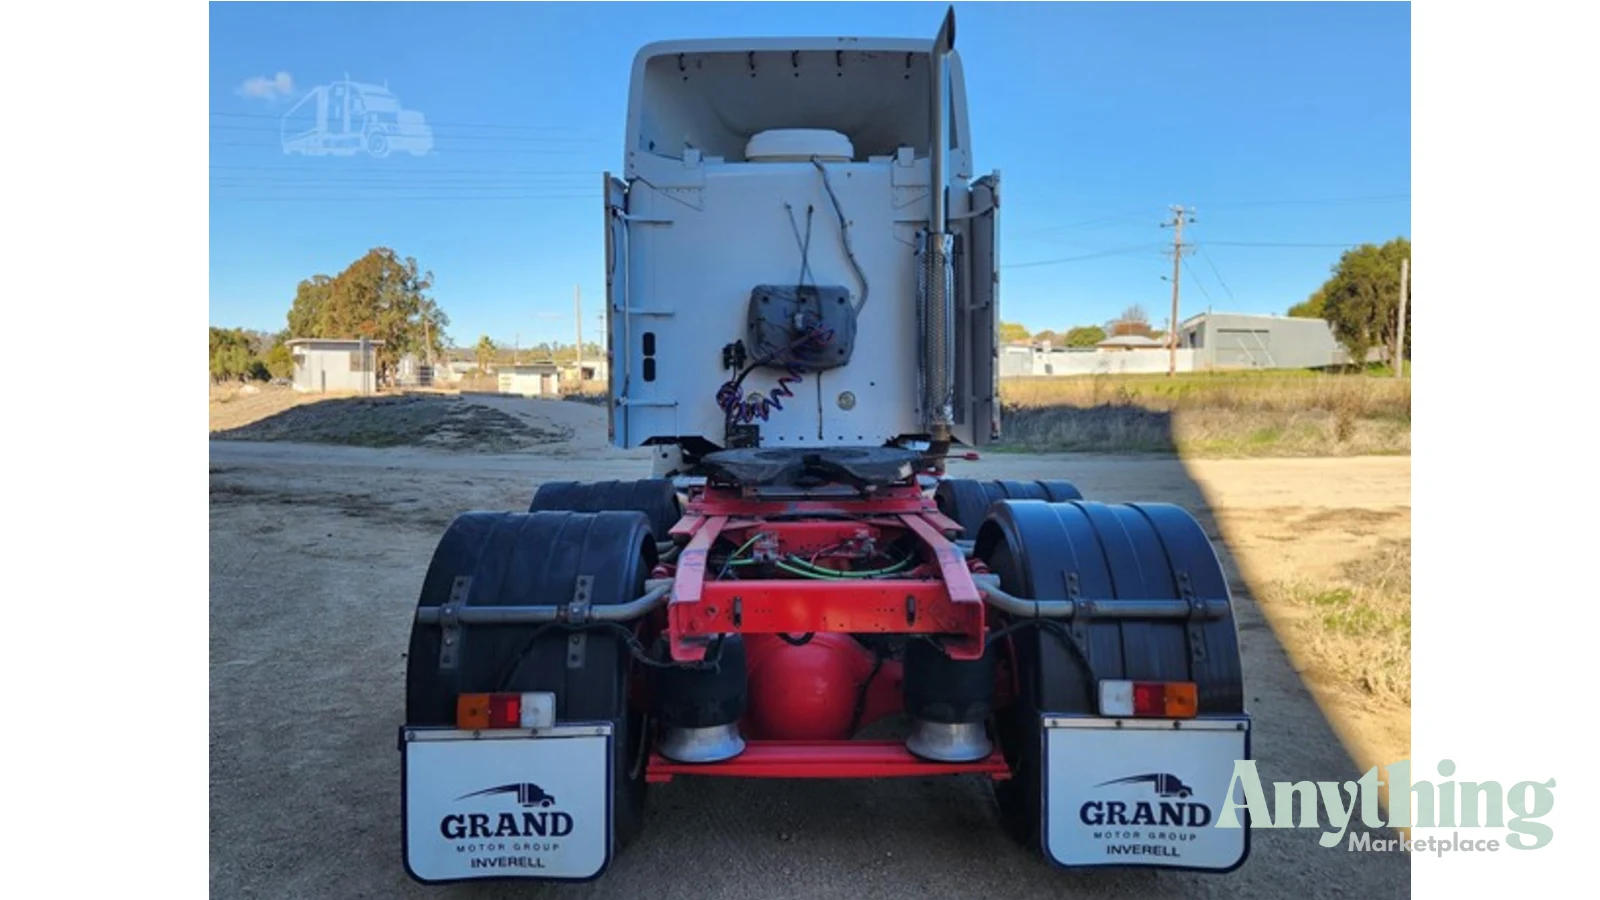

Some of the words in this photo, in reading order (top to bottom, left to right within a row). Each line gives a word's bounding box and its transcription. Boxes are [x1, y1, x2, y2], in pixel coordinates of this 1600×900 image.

[1079, 801, 1212, 827] GRAND
[440, 812, 574, 839] GRAND
[1093, 831, 1141, 839] MOTOR
[1148, 832, 1197, 841] GROUP
[456, 843, 505, 853] MOTOR
[513, 843, 560, 852] GROUP
[1106, 844, 1181, 858] INVERELL
[471, 856, 546, 868] INVERELL
